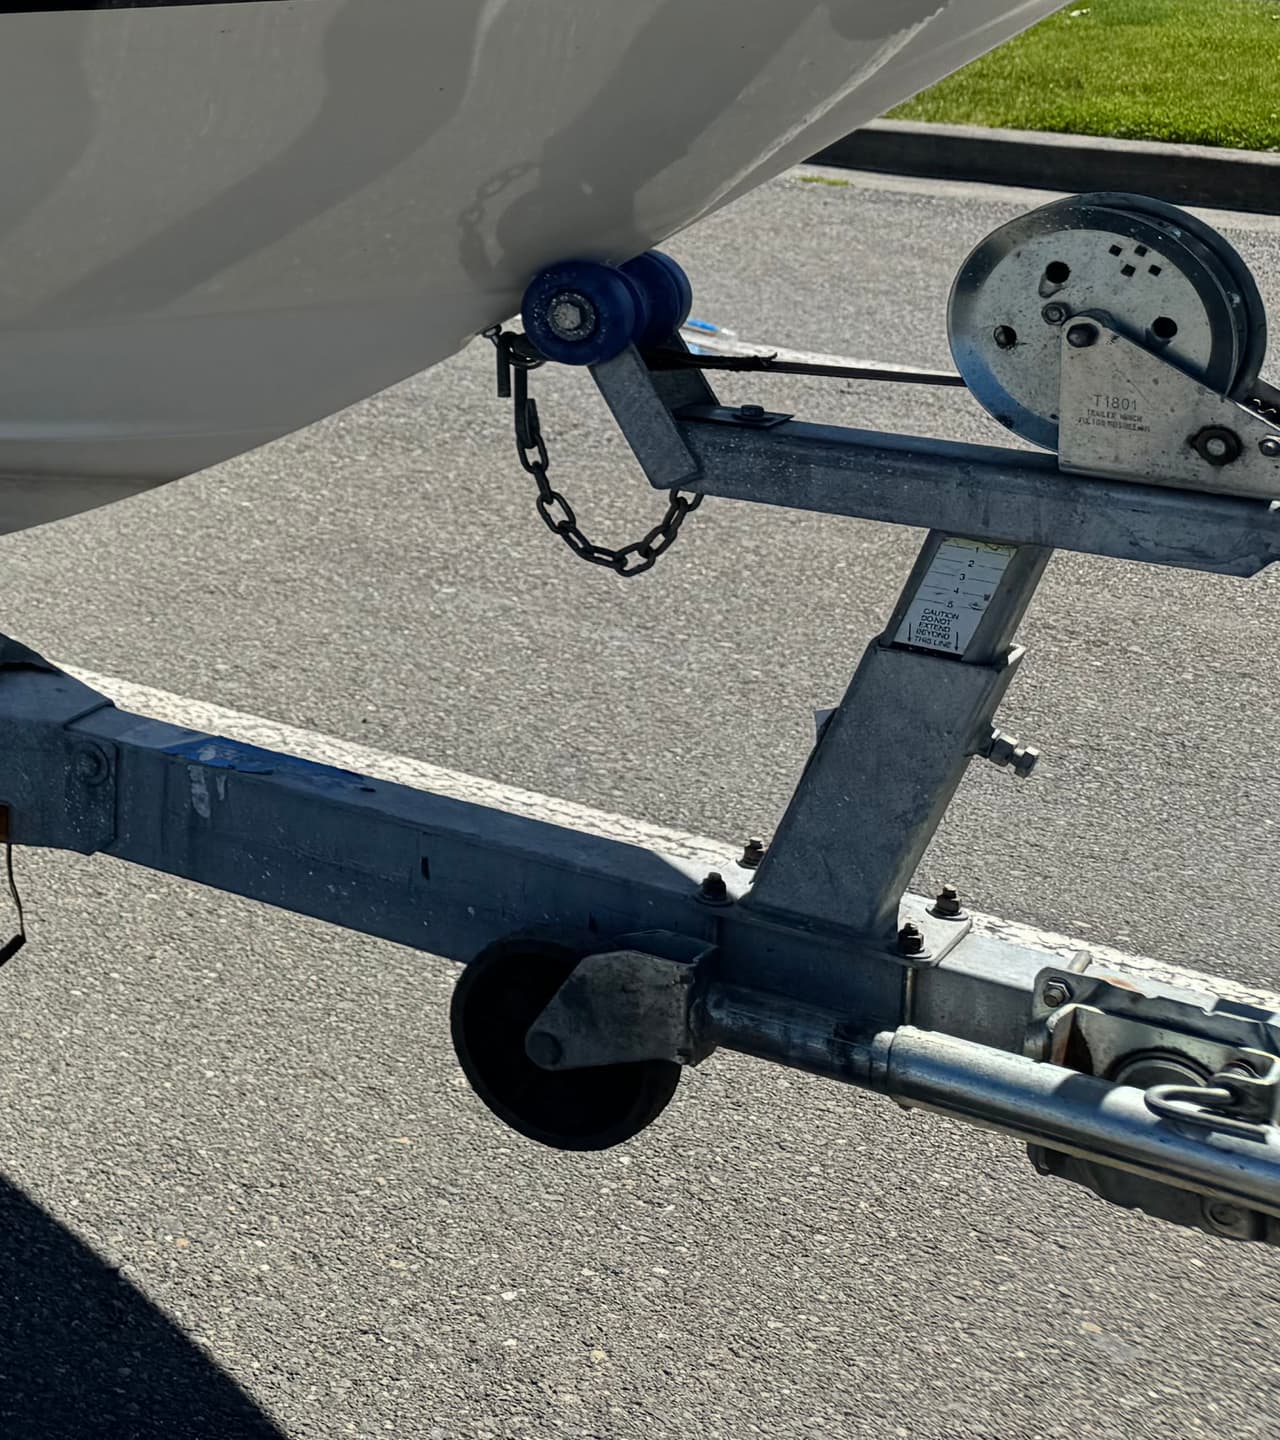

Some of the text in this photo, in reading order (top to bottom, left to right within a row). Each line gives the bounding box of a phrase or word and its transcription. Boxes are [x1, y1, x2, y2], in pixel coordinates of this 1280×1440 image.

[1093, 394, 1137, 411] T1801
[923, 608, 960, 620] CAUTION
[934, 616, 953, 625] NOT
[918, 621, 951, 633] EXTEND
[915, 628, 950, 640] BEYOND
